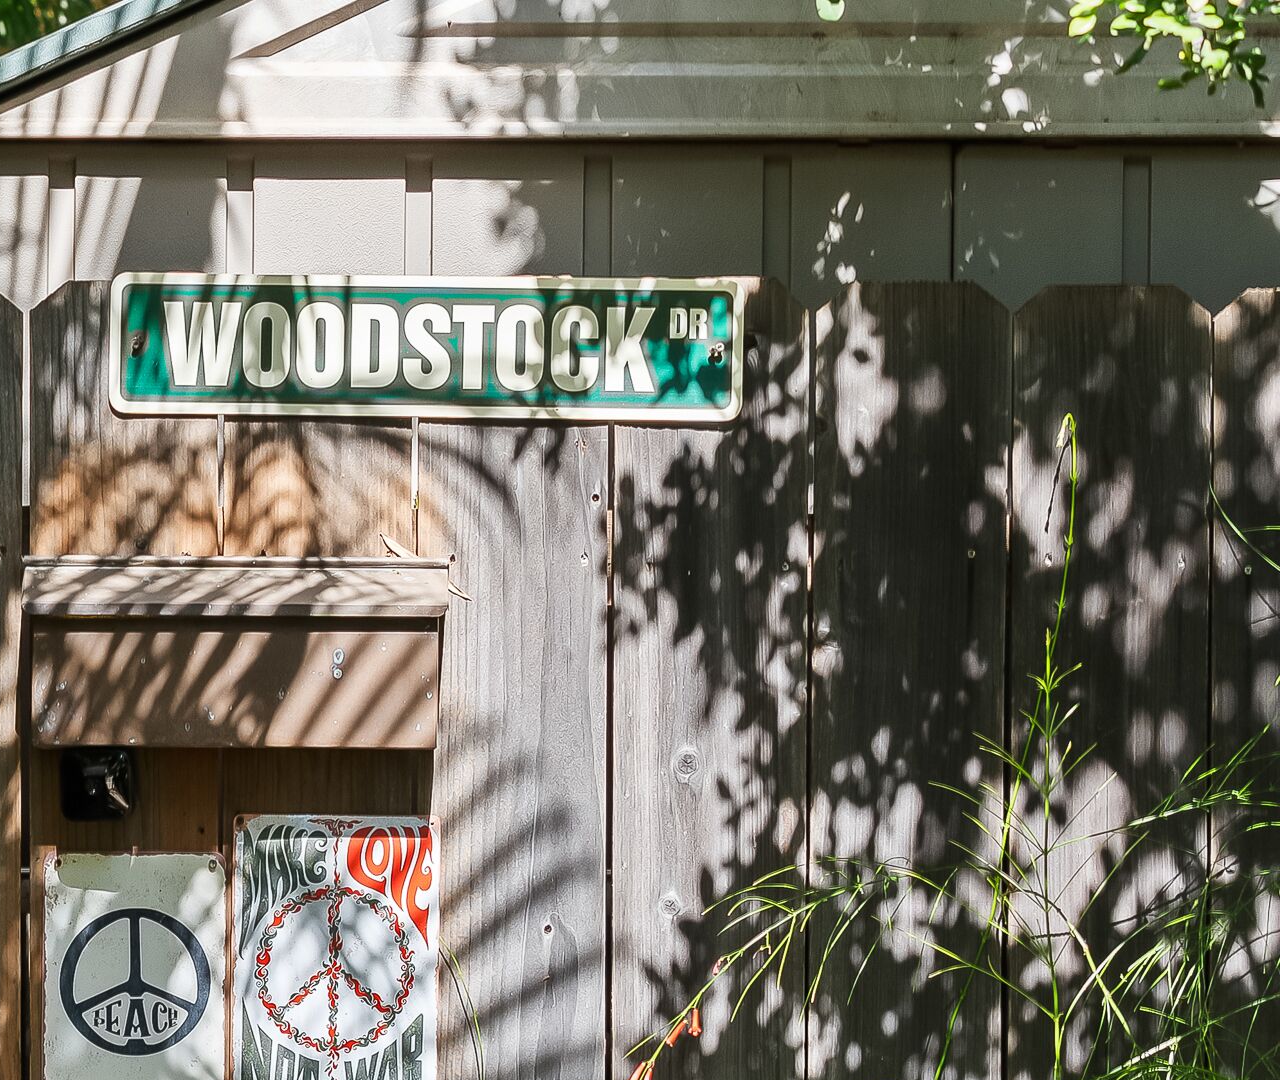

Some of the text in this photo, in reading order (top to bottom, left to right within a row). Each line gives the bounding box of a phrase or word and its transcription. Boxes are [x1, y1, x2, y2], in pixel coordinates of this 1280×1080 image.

[163, 300, 708, 393] WOODSTOCK DR
[240, 824, 433, 958] MAKE LOVE
